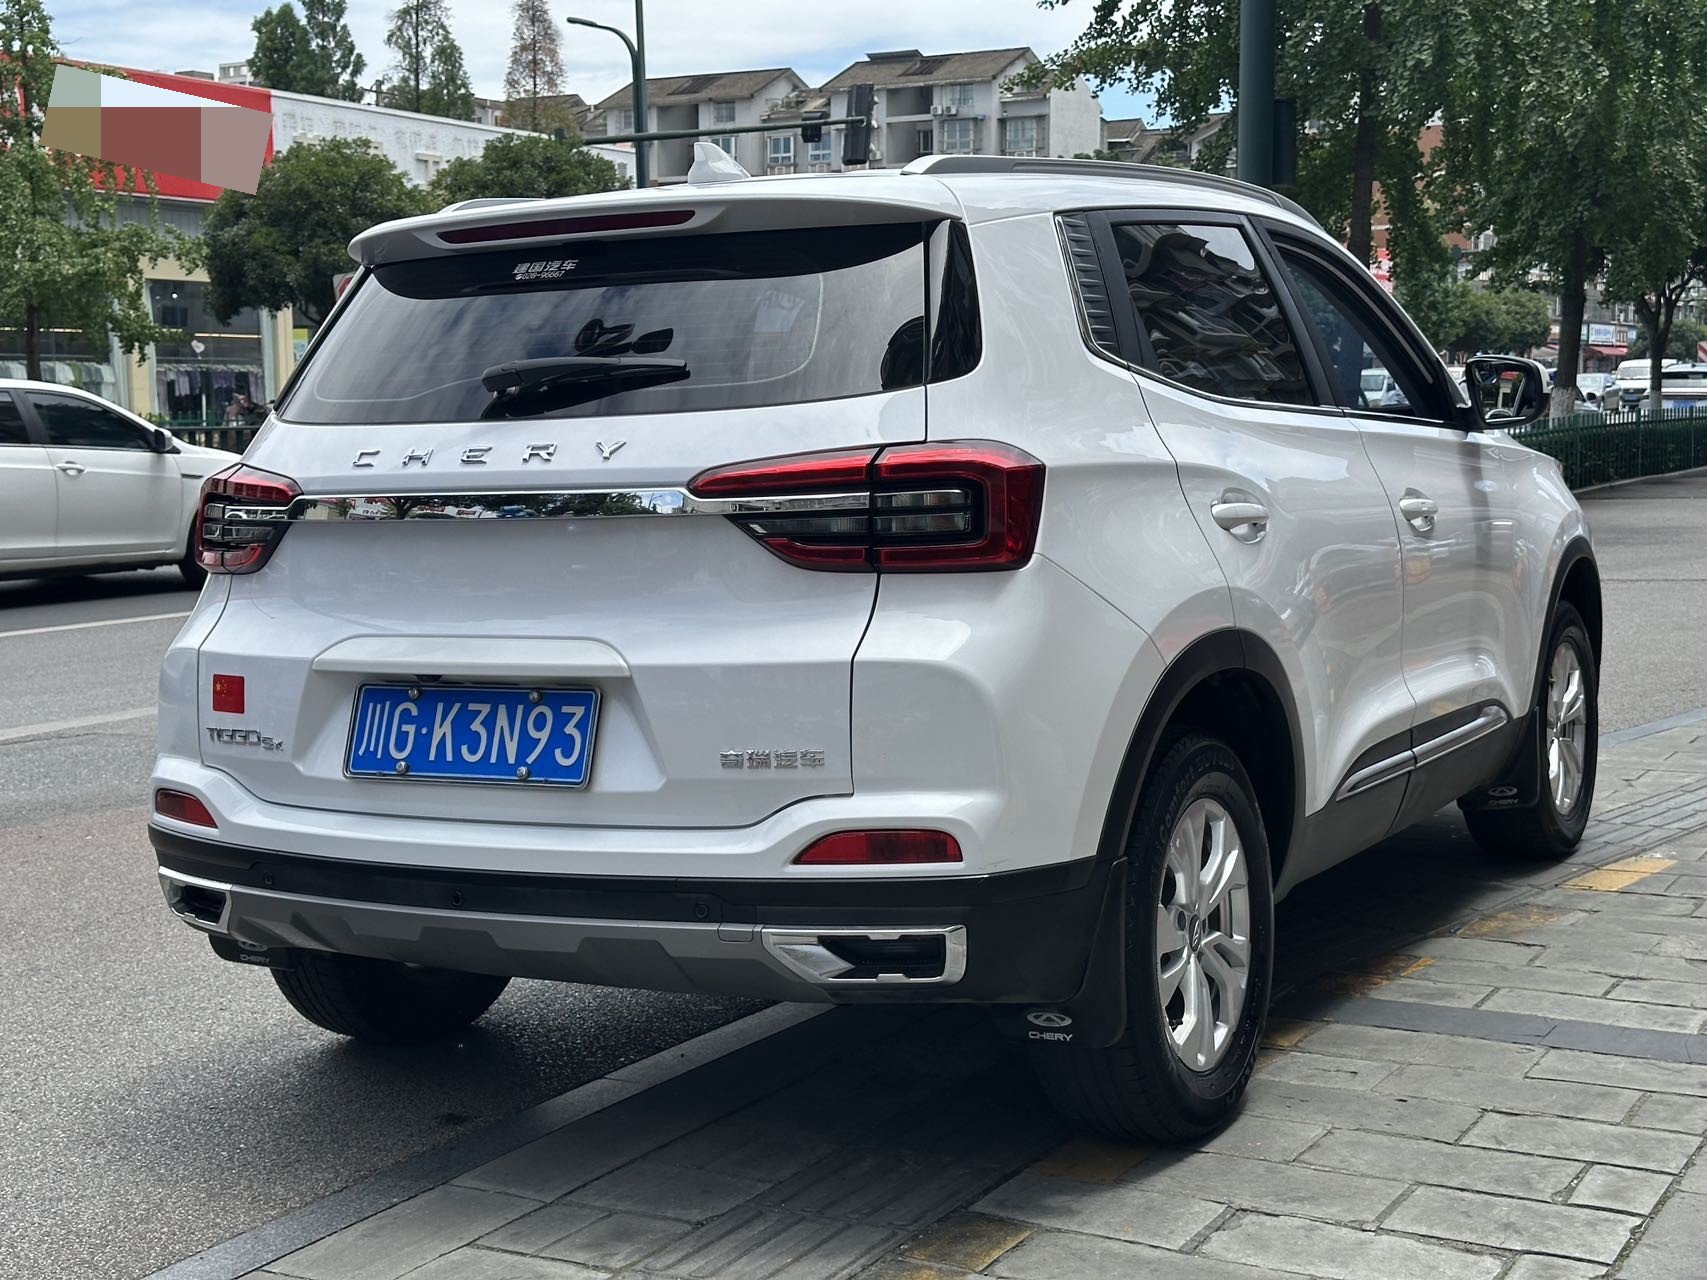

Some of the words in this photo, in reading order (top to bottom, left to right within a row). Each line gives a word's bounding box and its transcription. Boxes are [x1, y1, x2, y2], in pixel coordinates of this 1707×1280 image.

[352, 440, 627, 468] CHERY
[719, 749, 825, 769] 奇瑞汽车
[1028, 1031, 1073, 1042] CHERY
